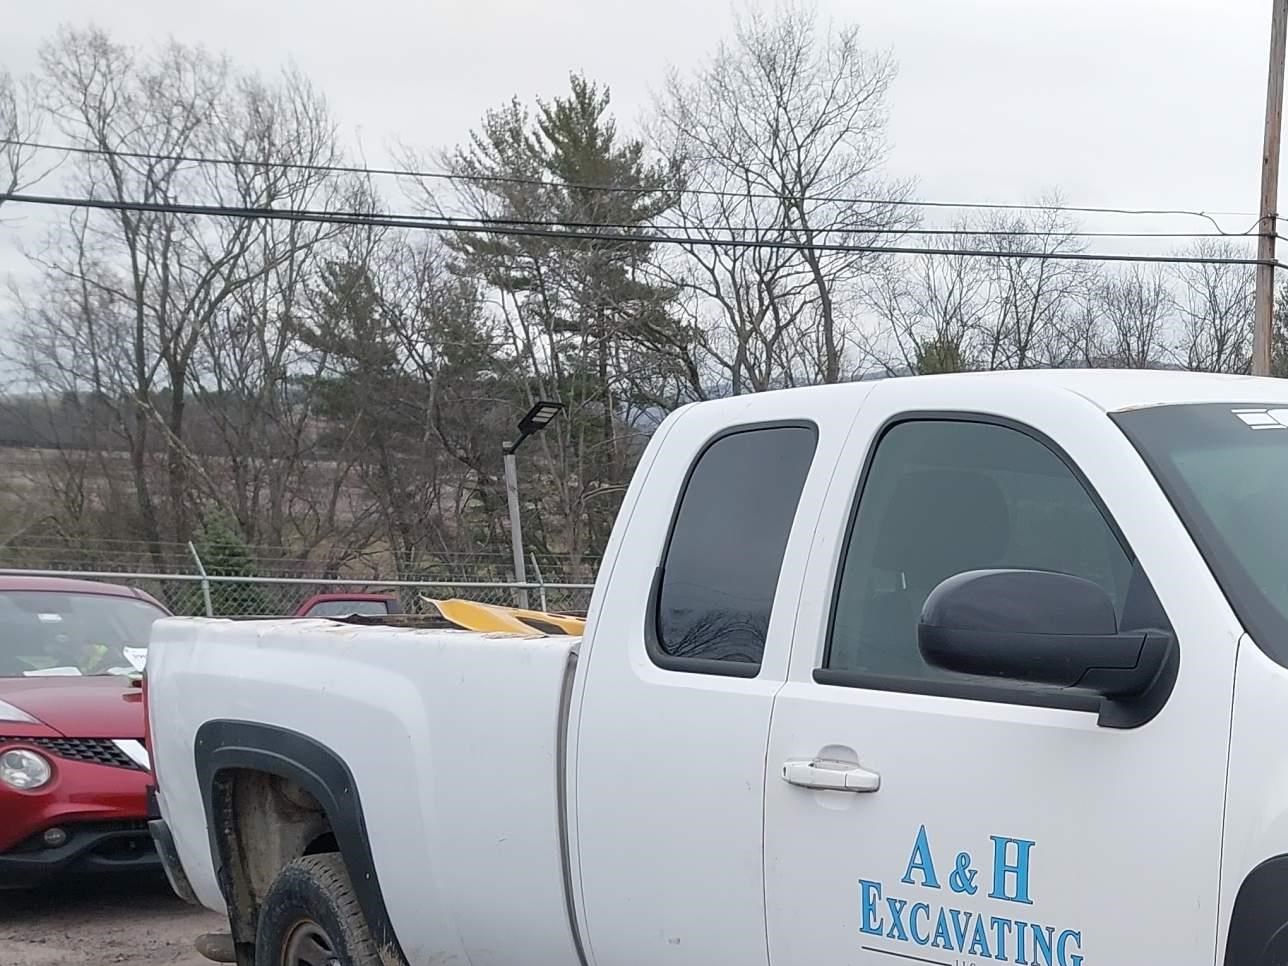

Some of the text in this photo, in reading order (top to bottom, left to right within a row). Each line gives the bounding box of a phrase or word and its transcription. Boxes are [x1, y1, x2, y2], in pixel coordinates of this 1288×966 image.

[901, 824, 1036, 905] A & H
